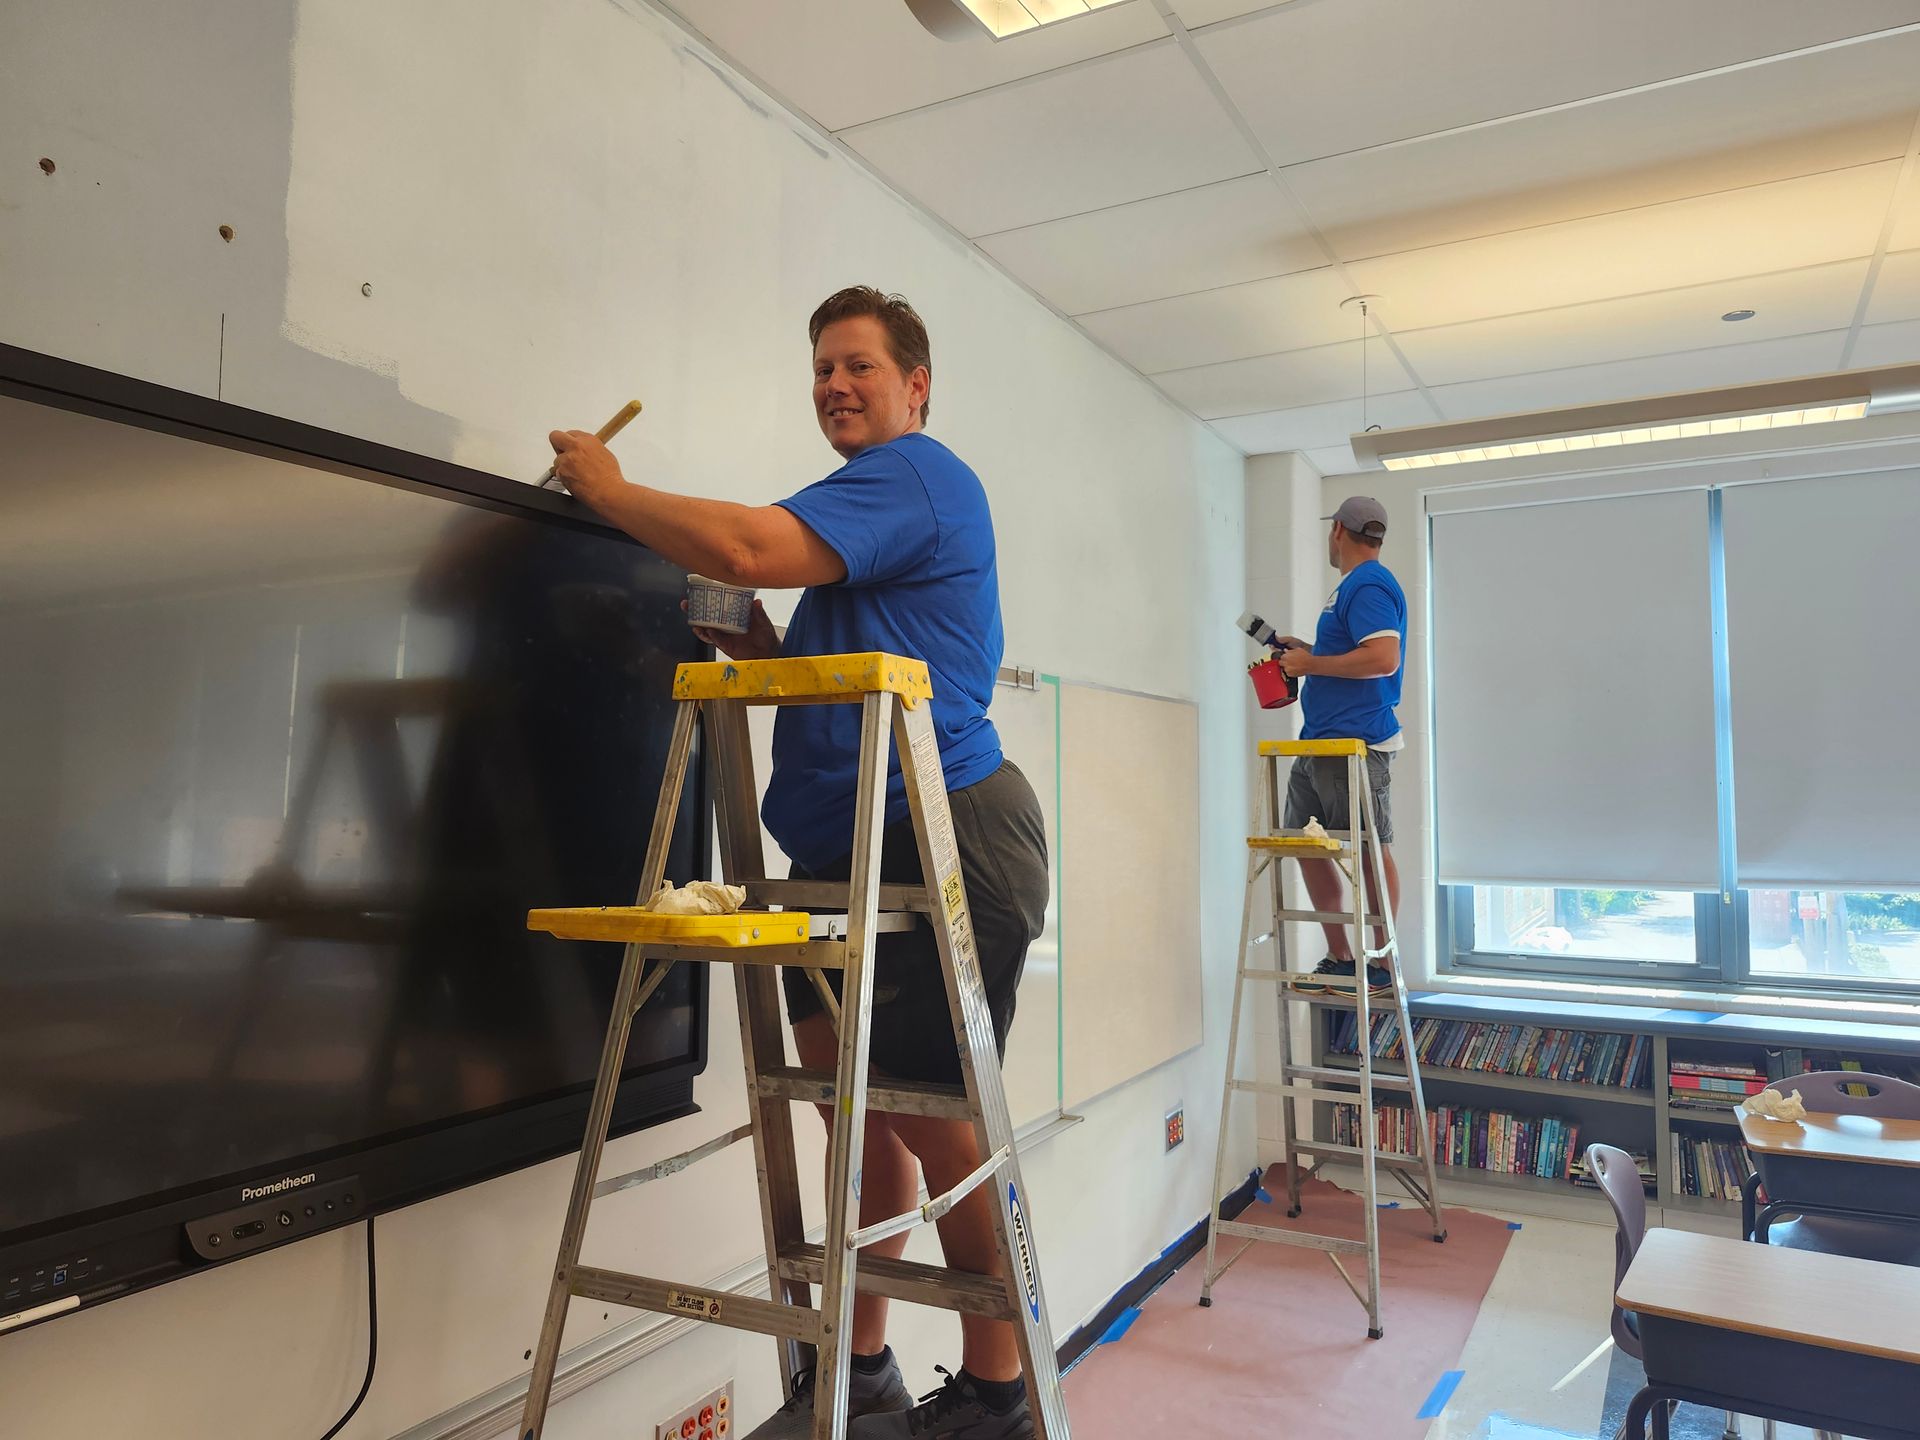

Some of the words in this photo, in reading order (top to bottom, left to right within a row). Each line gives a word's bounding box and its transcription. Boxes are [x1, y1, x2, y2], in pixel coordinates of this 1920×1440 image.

[241, 1173, 316, 1202] Promethean
[1012, 1211, 1036, 1298] WERNER
[687, 1303, 704, 1311] SECTION
